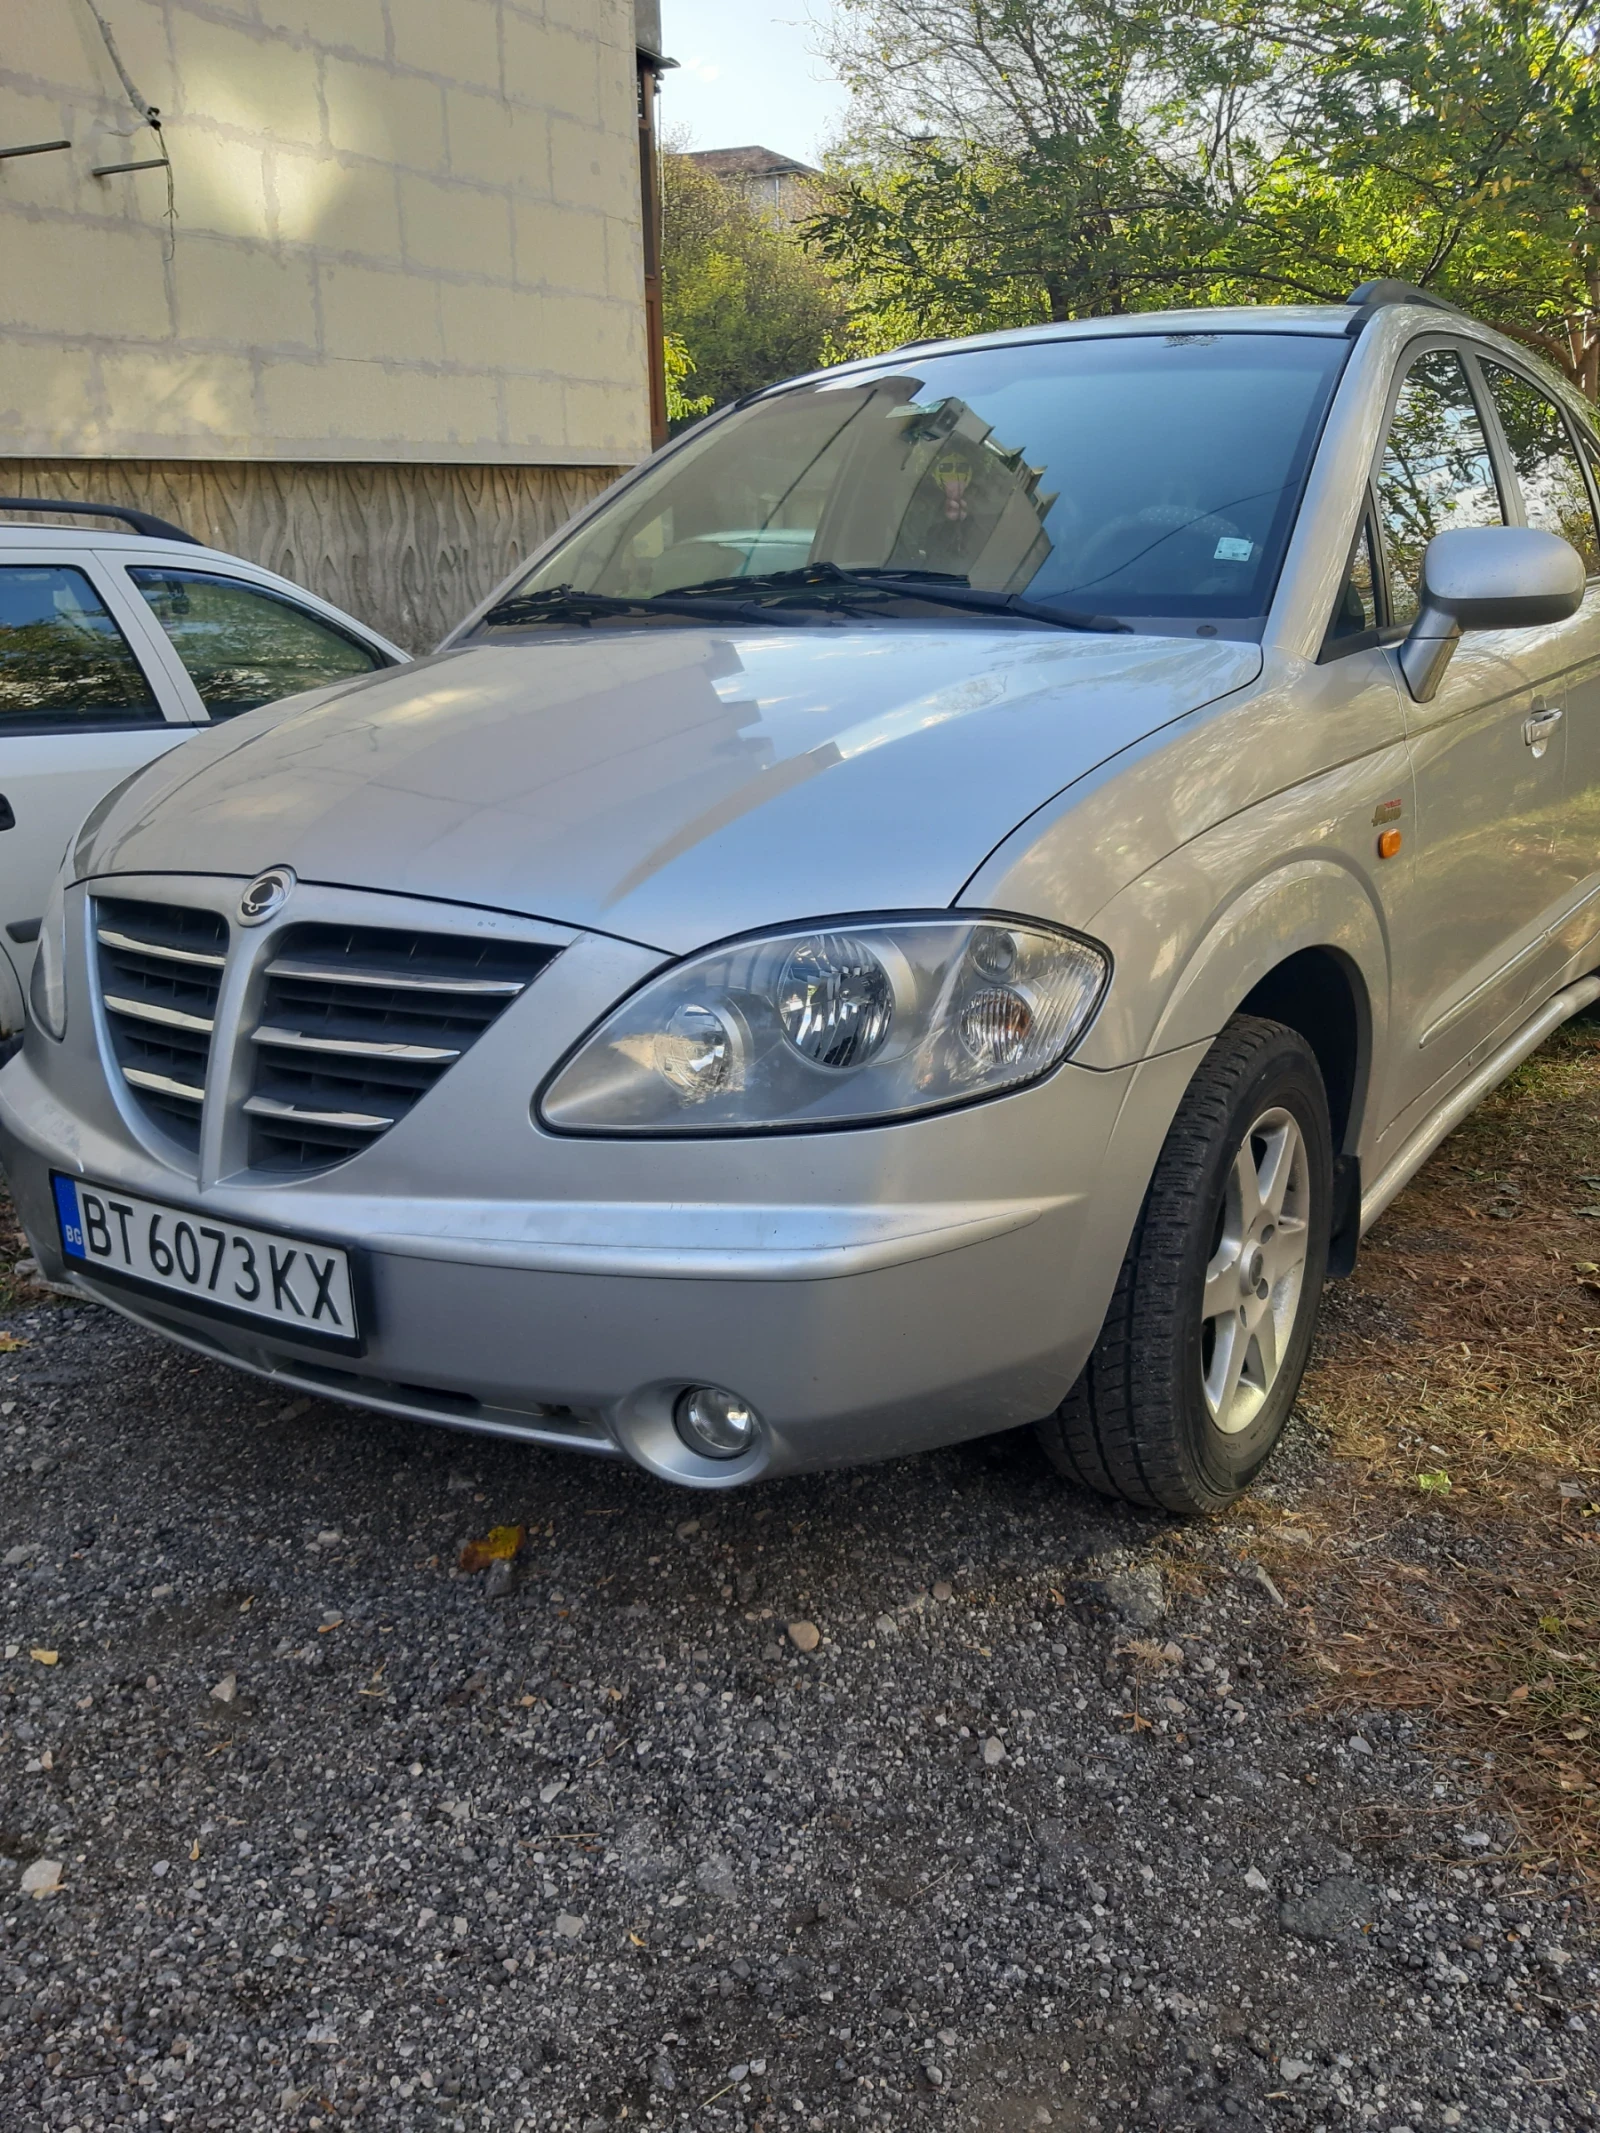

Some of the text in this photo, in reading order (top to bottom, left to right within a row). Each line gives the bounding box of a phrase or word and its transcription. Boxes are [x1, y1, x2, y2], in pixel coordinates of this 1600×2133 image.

[65, 1225, 82, 1246] BG
[82, 1192, 343, 1326] BT 6073 KX
